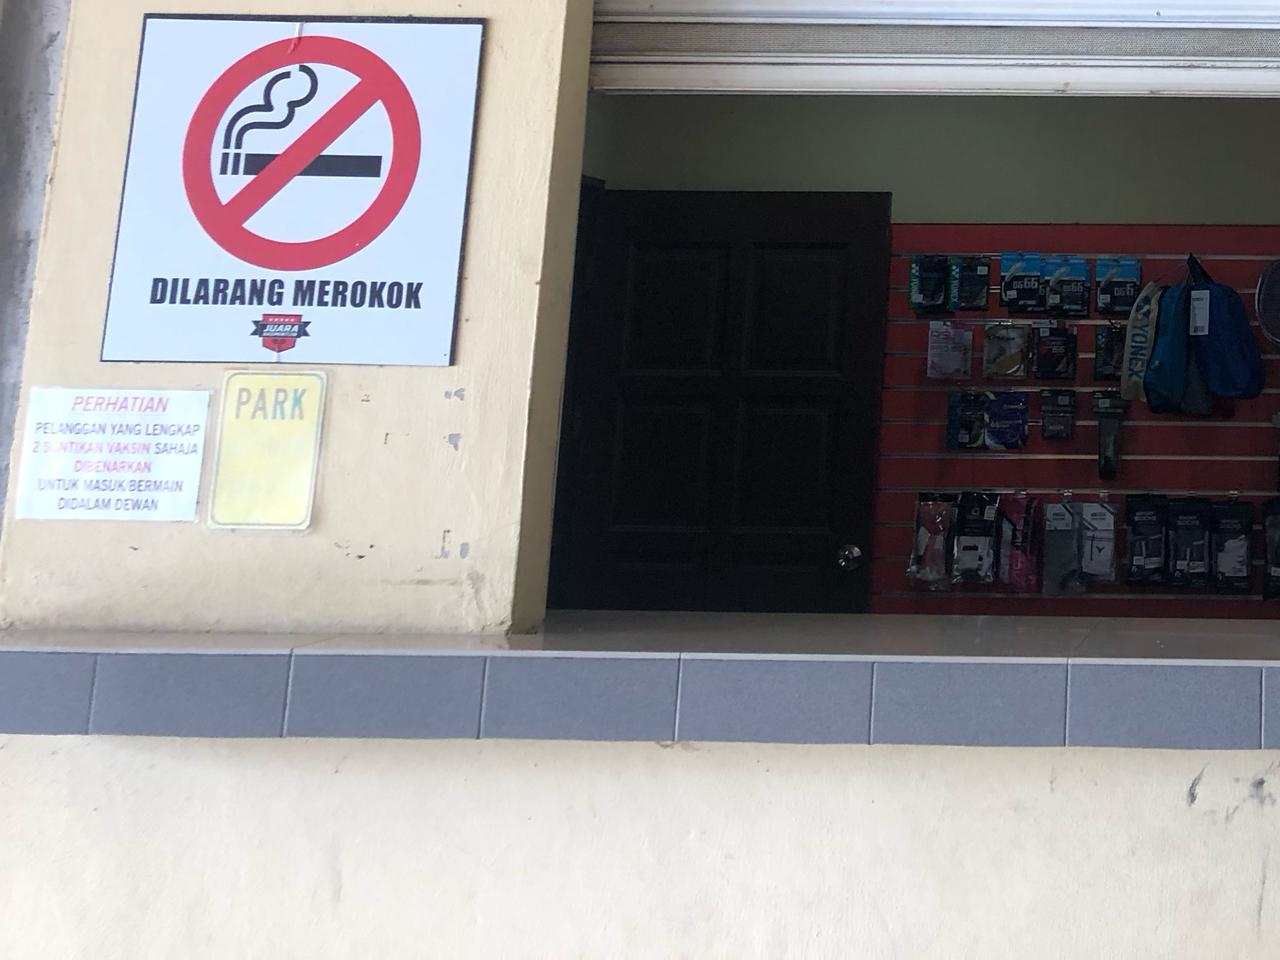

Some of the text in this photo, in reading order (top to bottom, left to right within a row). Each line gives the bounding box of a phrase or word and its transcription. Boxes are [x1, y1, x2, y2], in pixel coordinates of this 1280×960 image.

[150, 277, 424, 309] DILARANG MEROKOK
[263, 324, 299, 333] JUARA
[1129, 323, 1149, 379] YONEX
[71, 396, 170, 413] PERHATIAN
[235, 387, 308, 420] PARK
[35, 421, 200, 437] PELANGGAN YANG LENGKAP
[42, 441, 103, 454] SNTIKAN
[106, 442, 151, 455] VAKSIN
[154, 442, 199, 455] SAHAJA
[38, 478, 184, 493] UNTUK MASUK BERMAIN
[57, 496, 159, 511] DIDALAM DEWAN
